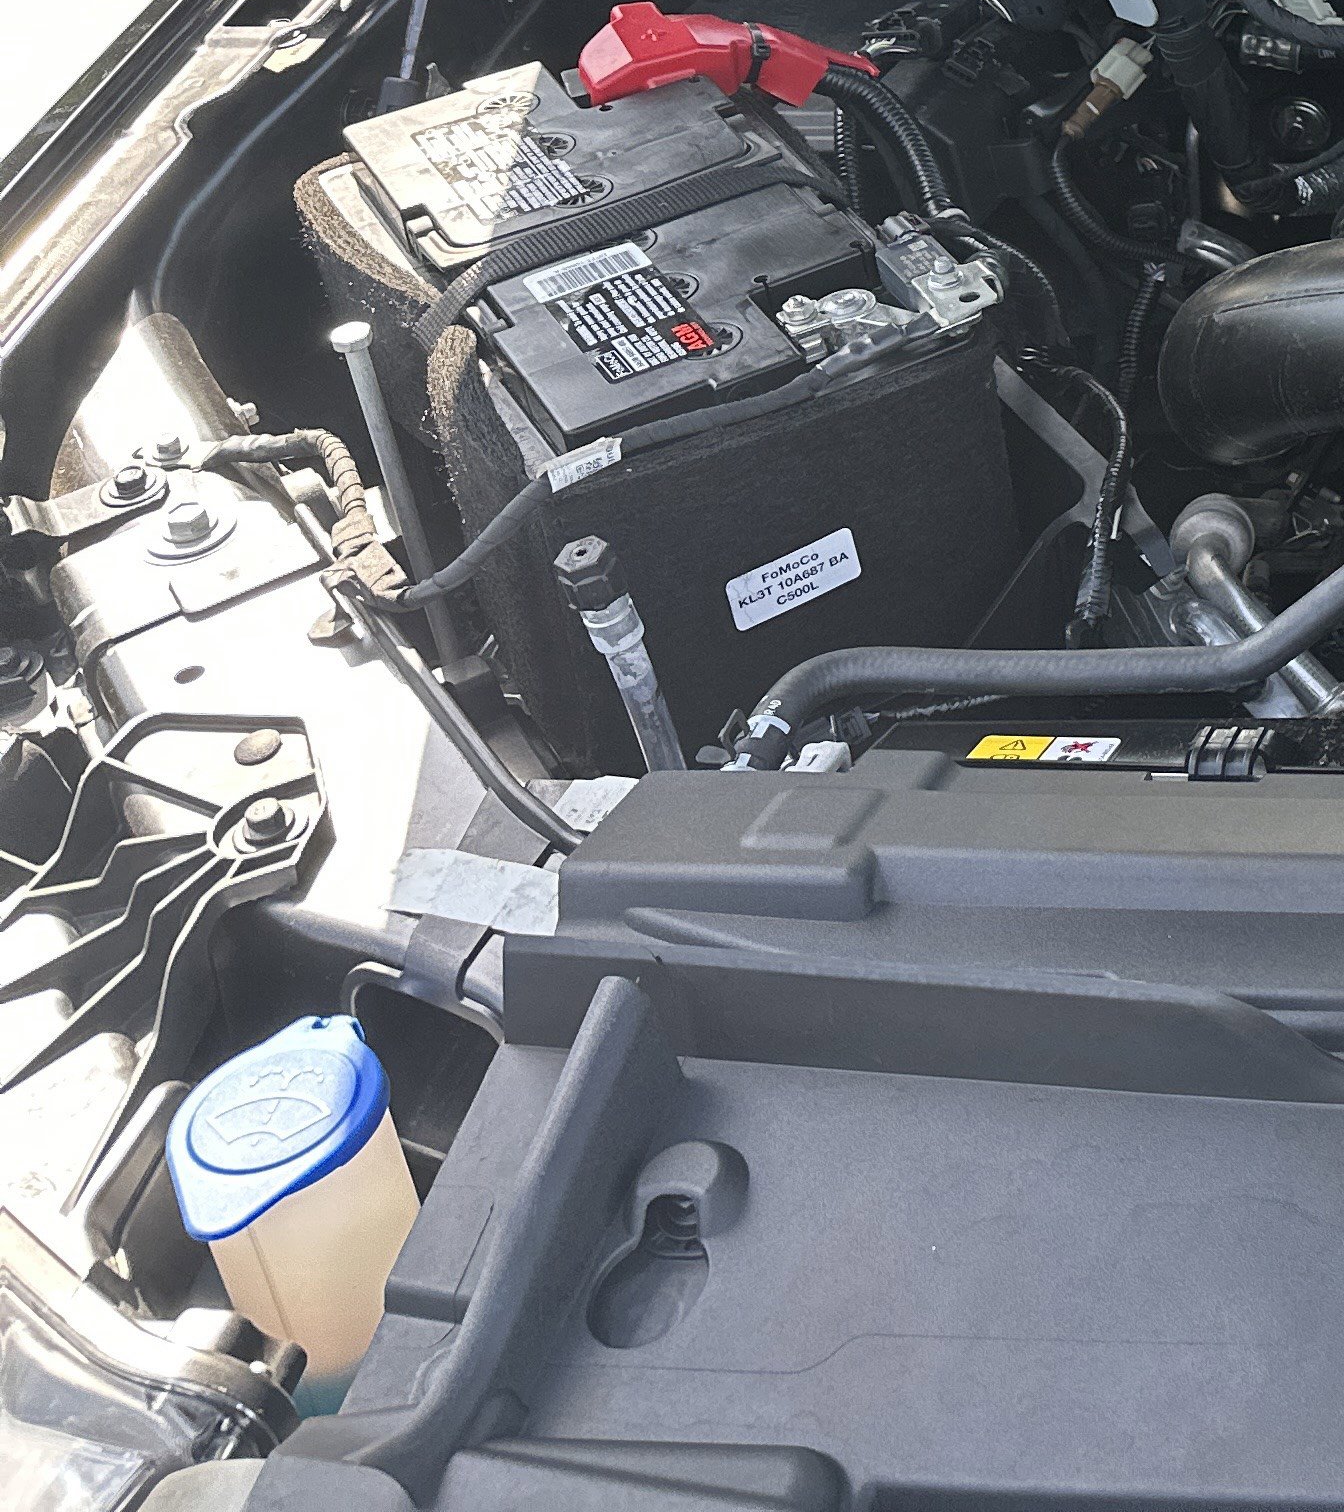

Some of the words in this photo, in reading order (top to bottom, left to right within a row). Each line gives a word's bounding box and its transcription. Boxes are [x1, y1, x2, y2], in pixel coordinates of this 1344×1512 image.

[671, 322, 708, 352] AGM
[738, 586, 773, 608] KL3T
[778, 562, 825, 590] 10A687
[829, 552, 849, 567] BA
[761, 553, 819, 583] FoMoCo
[776, 581, 820, 606] C500L
